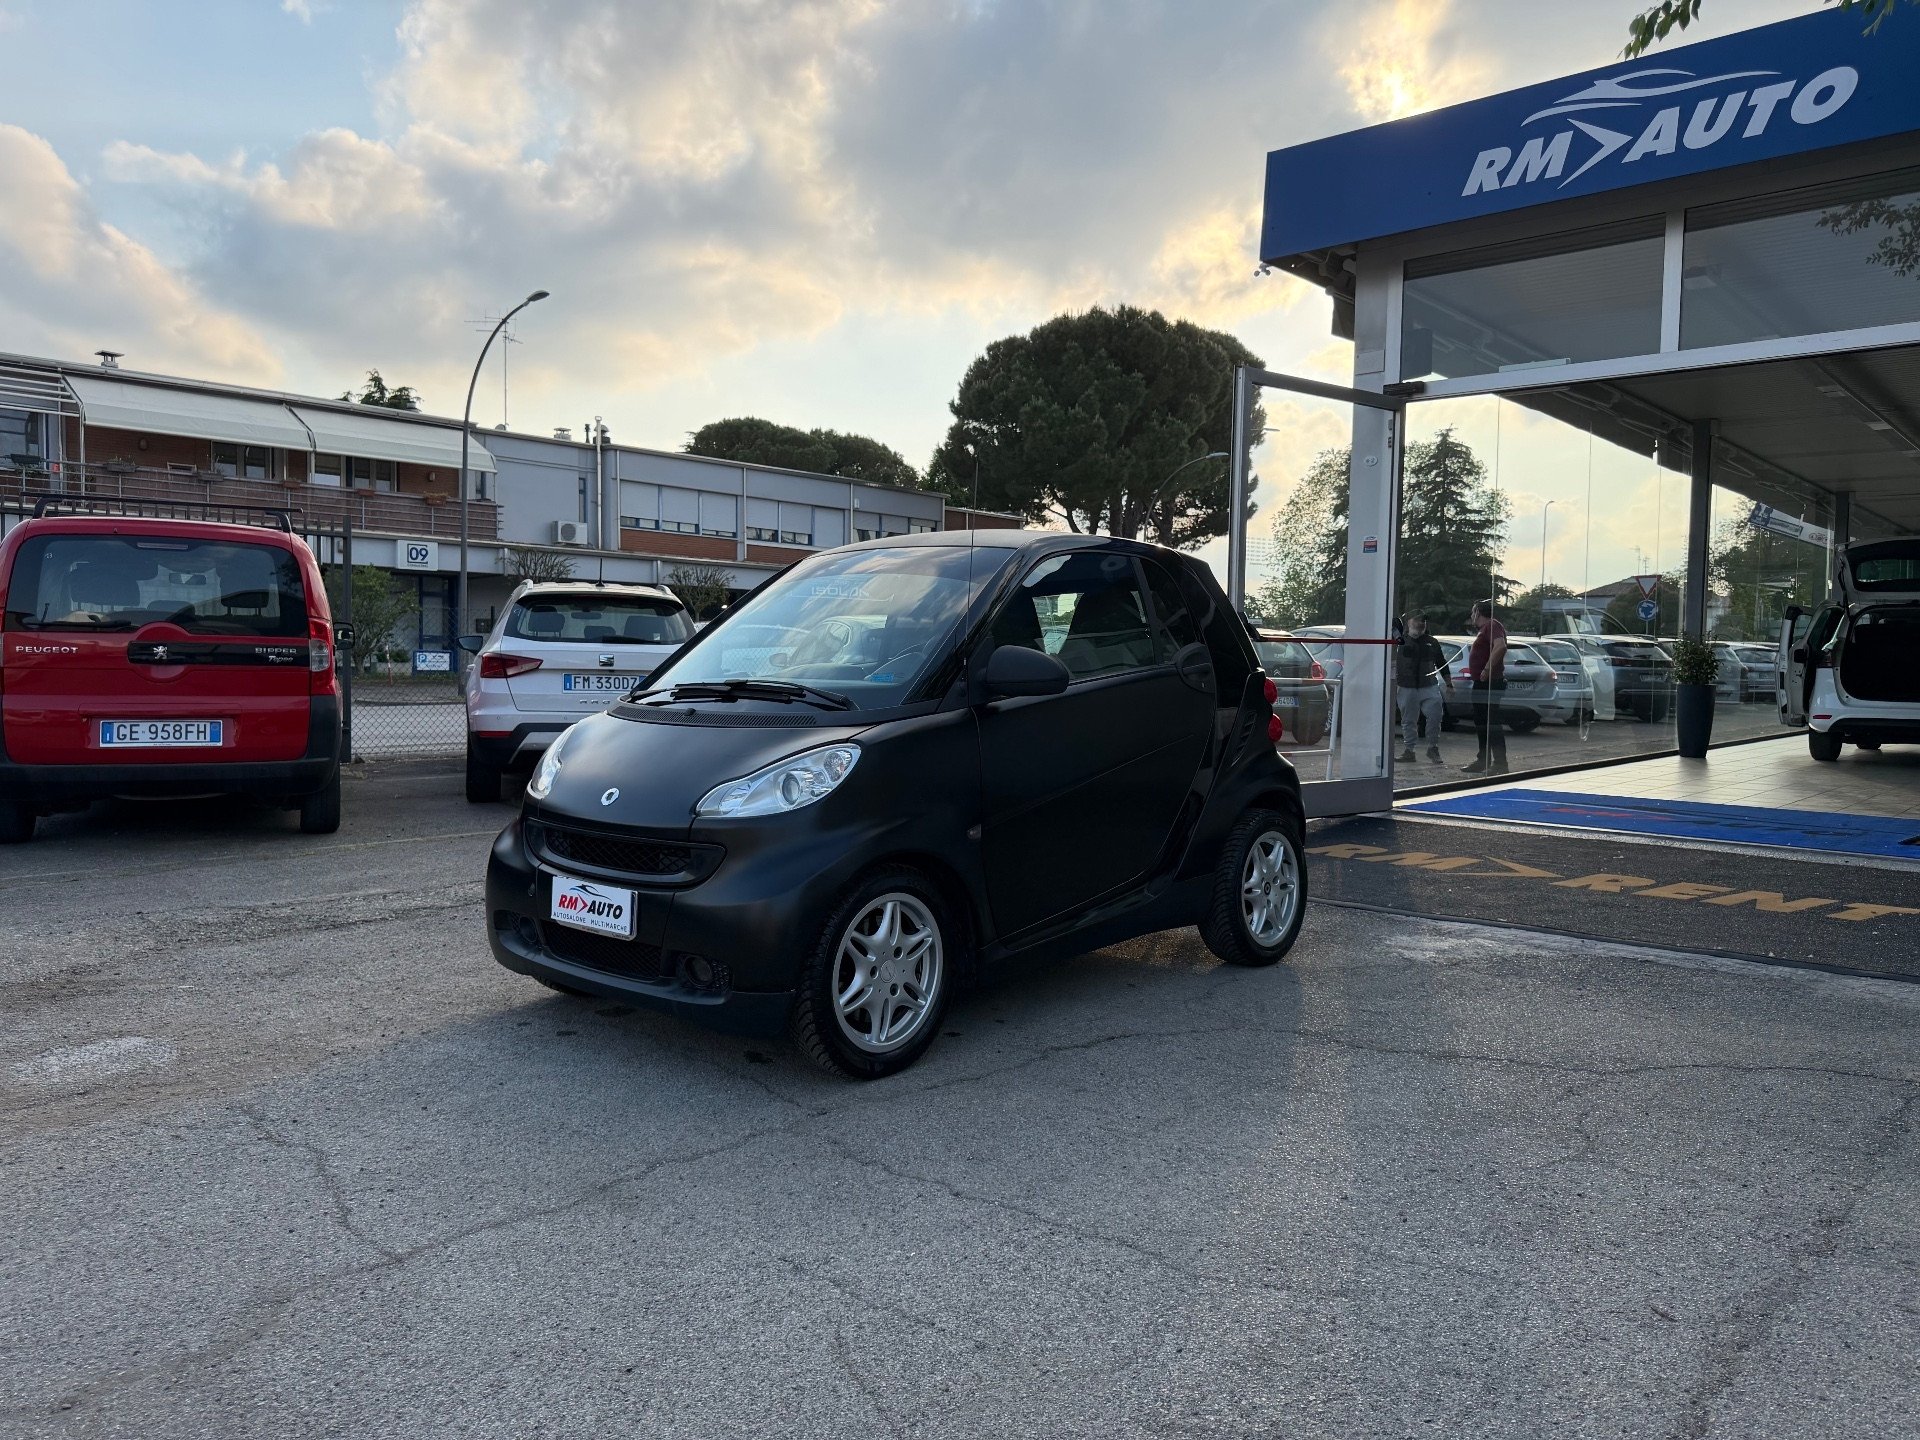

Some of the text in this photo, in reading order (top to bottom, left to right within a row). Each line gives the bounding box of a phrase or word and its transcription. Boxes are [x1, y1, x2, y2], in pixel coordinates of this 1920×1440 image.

[1621, 66, 1859, 163] AUTO
[409, 547, 429, 561] 09
[15, 645, 79, 654] PEUGEOT
[116, 723, 140, 741] GE
[148, 723, 207, 741] 958FH
[1549, 873, 1920, 921] RENT
[587, 900, 623, 919] AUTO
[553, 911, 586, 923] AUTOSALONE
[591, 919, 628, 932] MULTIMARCHE
